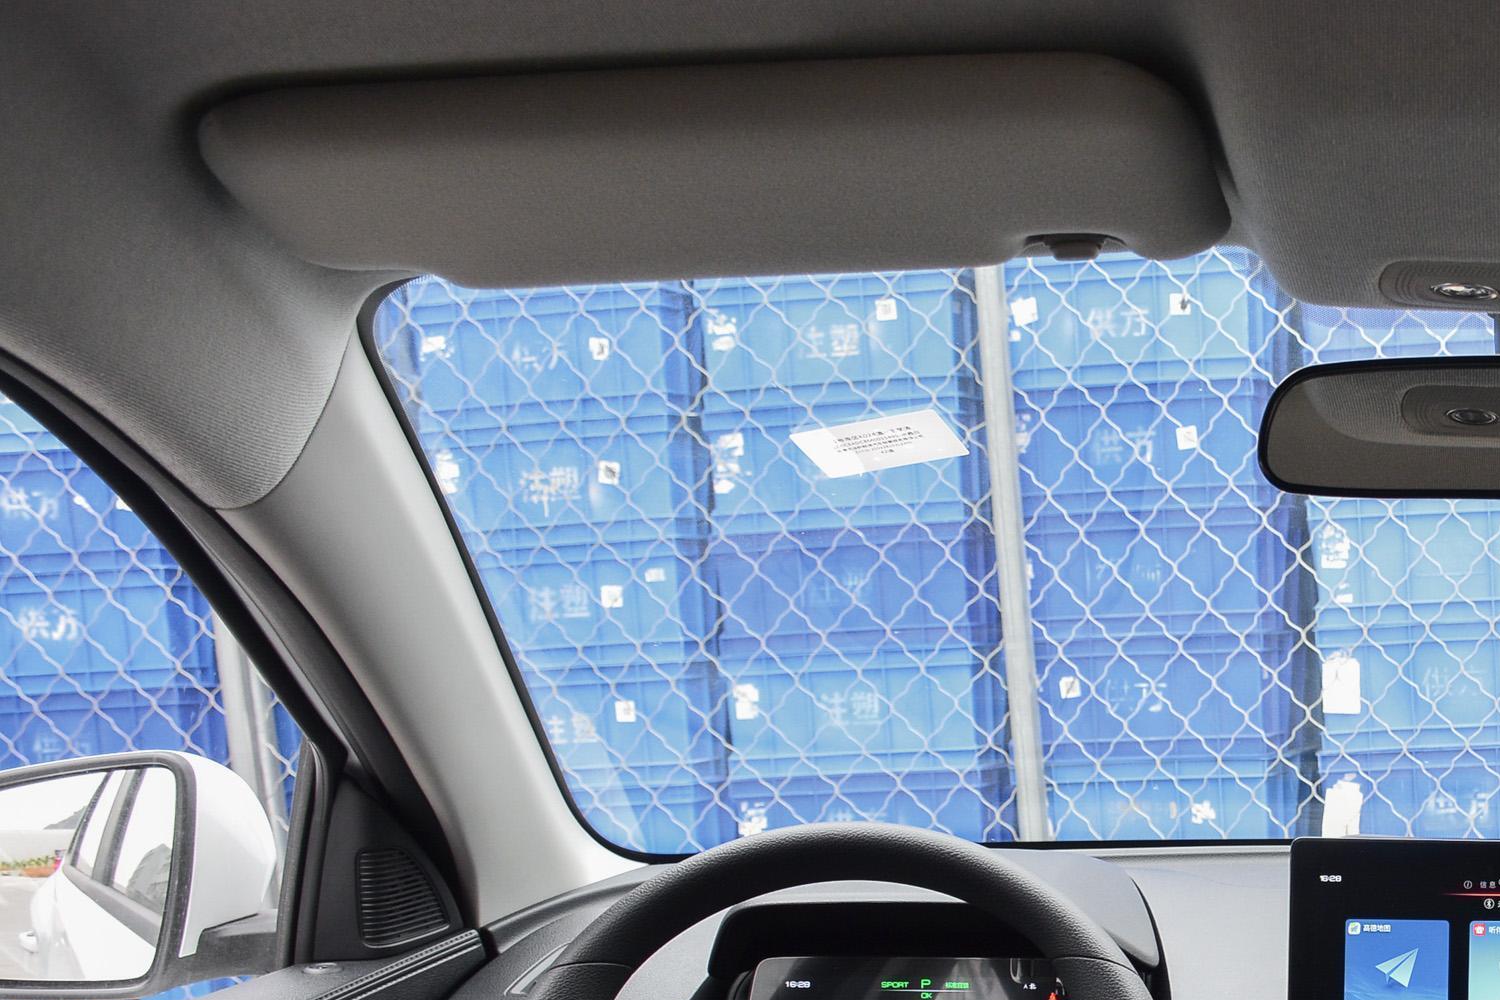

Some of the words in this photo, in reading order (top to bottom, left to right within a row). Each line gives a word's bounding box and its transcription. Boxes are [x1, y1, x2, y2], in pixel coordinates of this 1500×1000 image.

[1480, 880, 1496, 889] 信息
[1363, 924, 1392, 932] 高德地图
[920, 979, 932, 989] P
[920, 992, 932, 1000] OK
